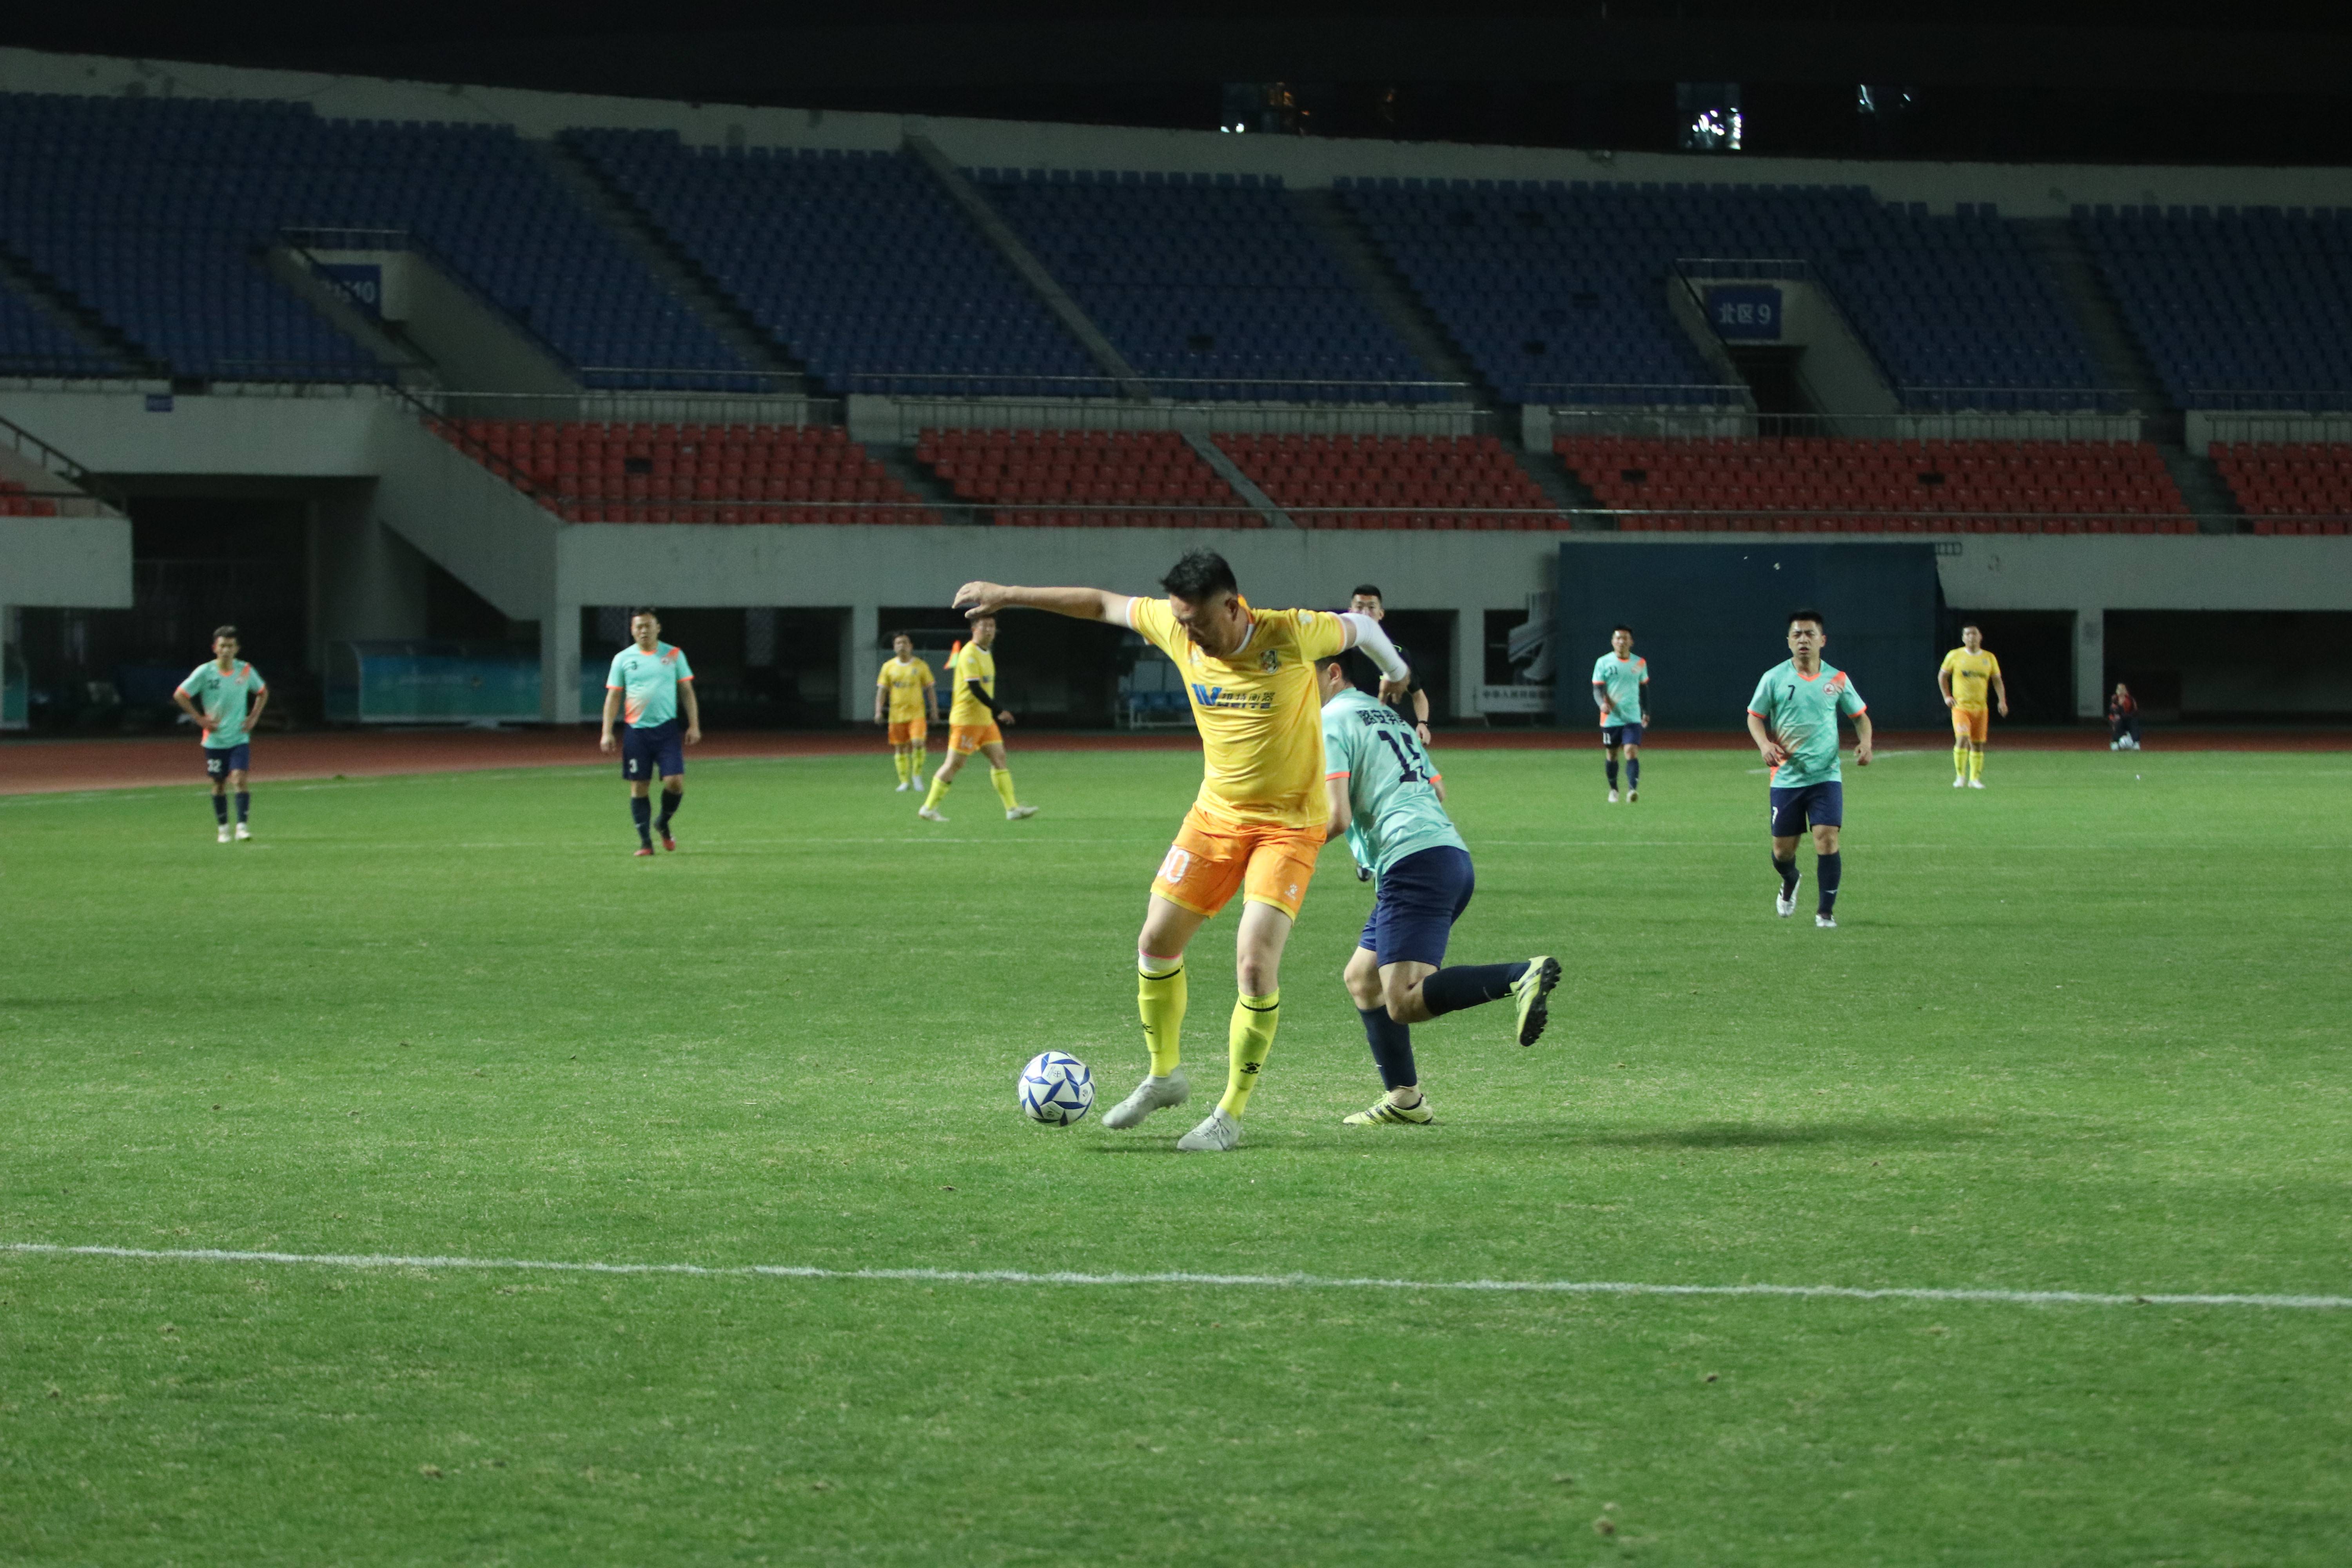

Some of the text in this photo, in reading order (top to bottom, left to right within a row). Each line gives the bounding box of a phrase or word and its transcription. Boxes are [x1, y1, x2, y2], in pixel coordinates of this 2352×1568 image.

[1788, 684, 1795, 701] 7
[629, 758, 638, 773] 3
[1377, 730, 1430, 784] 15
[207, 759, 222, 773] 32
[1772, 806, 1779, 825] 7
